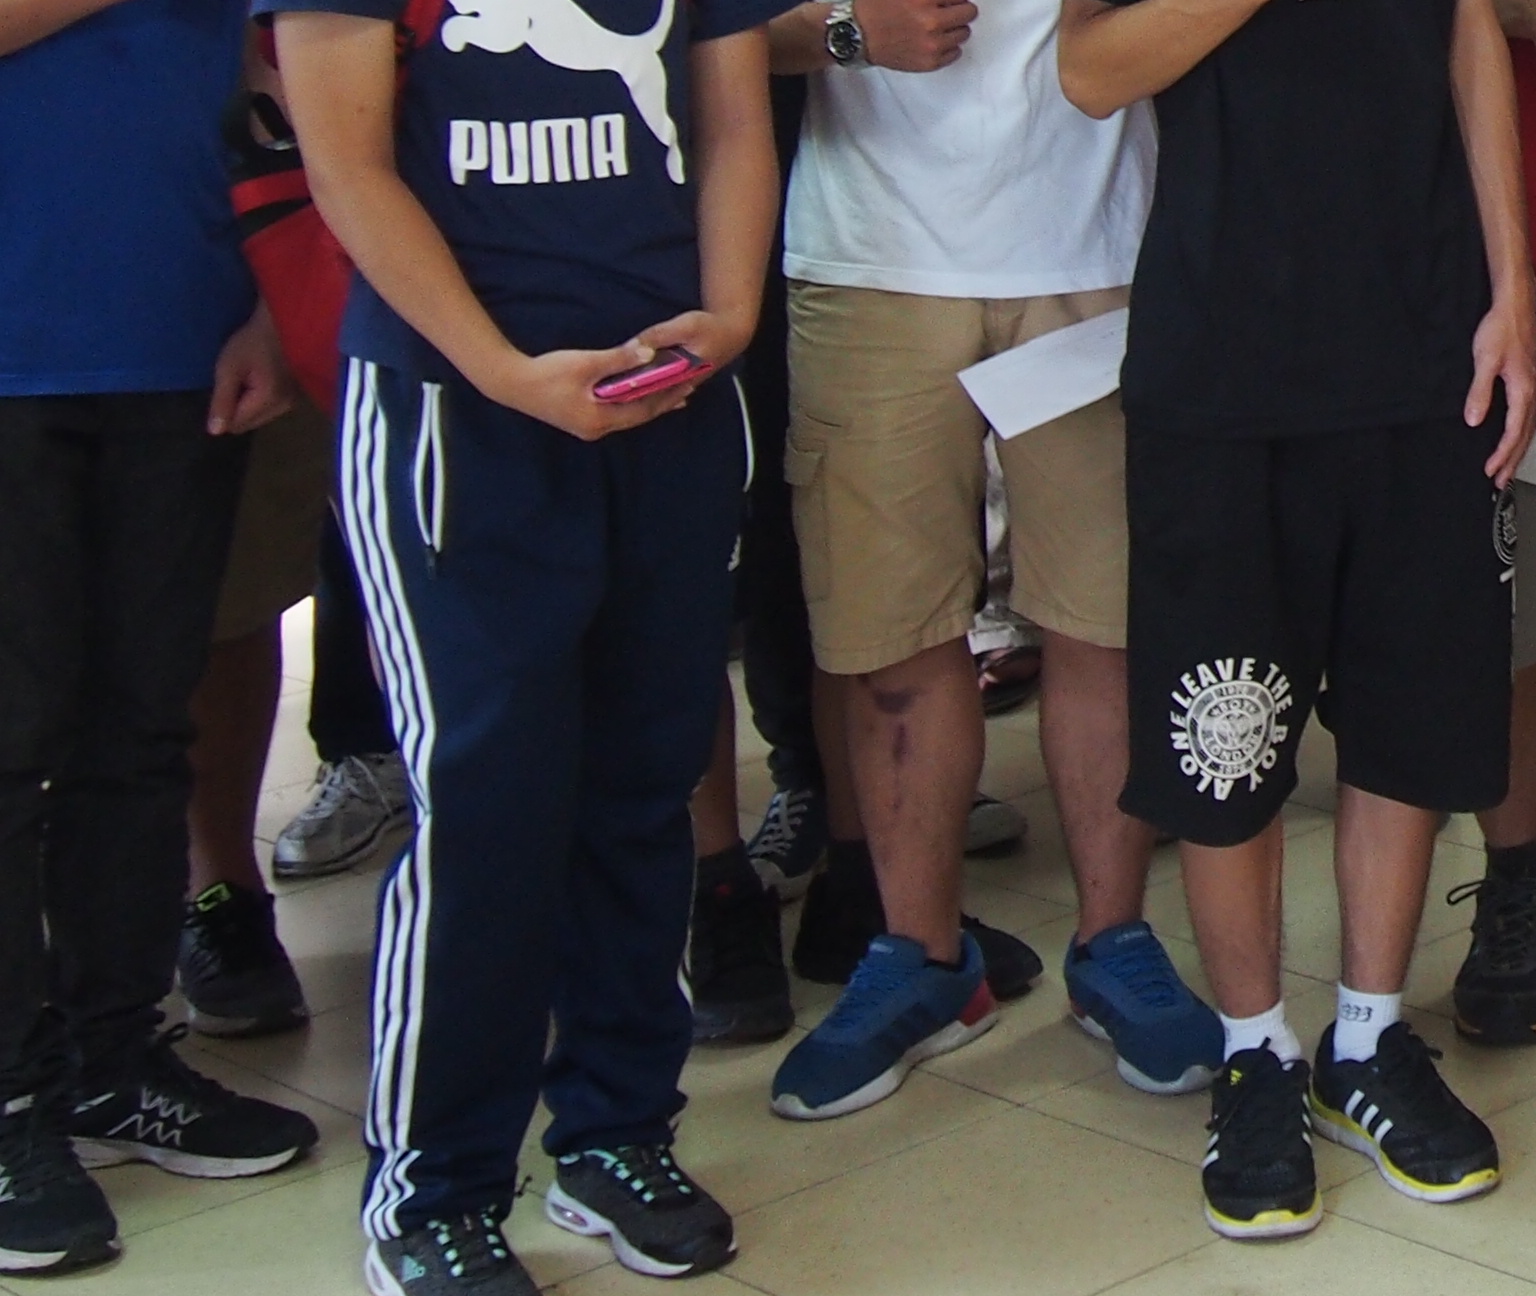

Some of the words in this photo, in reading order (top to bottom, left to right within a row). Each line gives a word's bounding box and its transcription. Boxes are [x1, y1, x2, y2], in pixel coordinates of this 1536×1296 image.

[450, 113, 629, 185] PUMA
[1171, 657, 1256, 709] LEAVE
[1262, 662, 1293, 715] THE
[1170, 710, 1236, 801] ALONE
[1249, 725, 1289, 793] BOY
